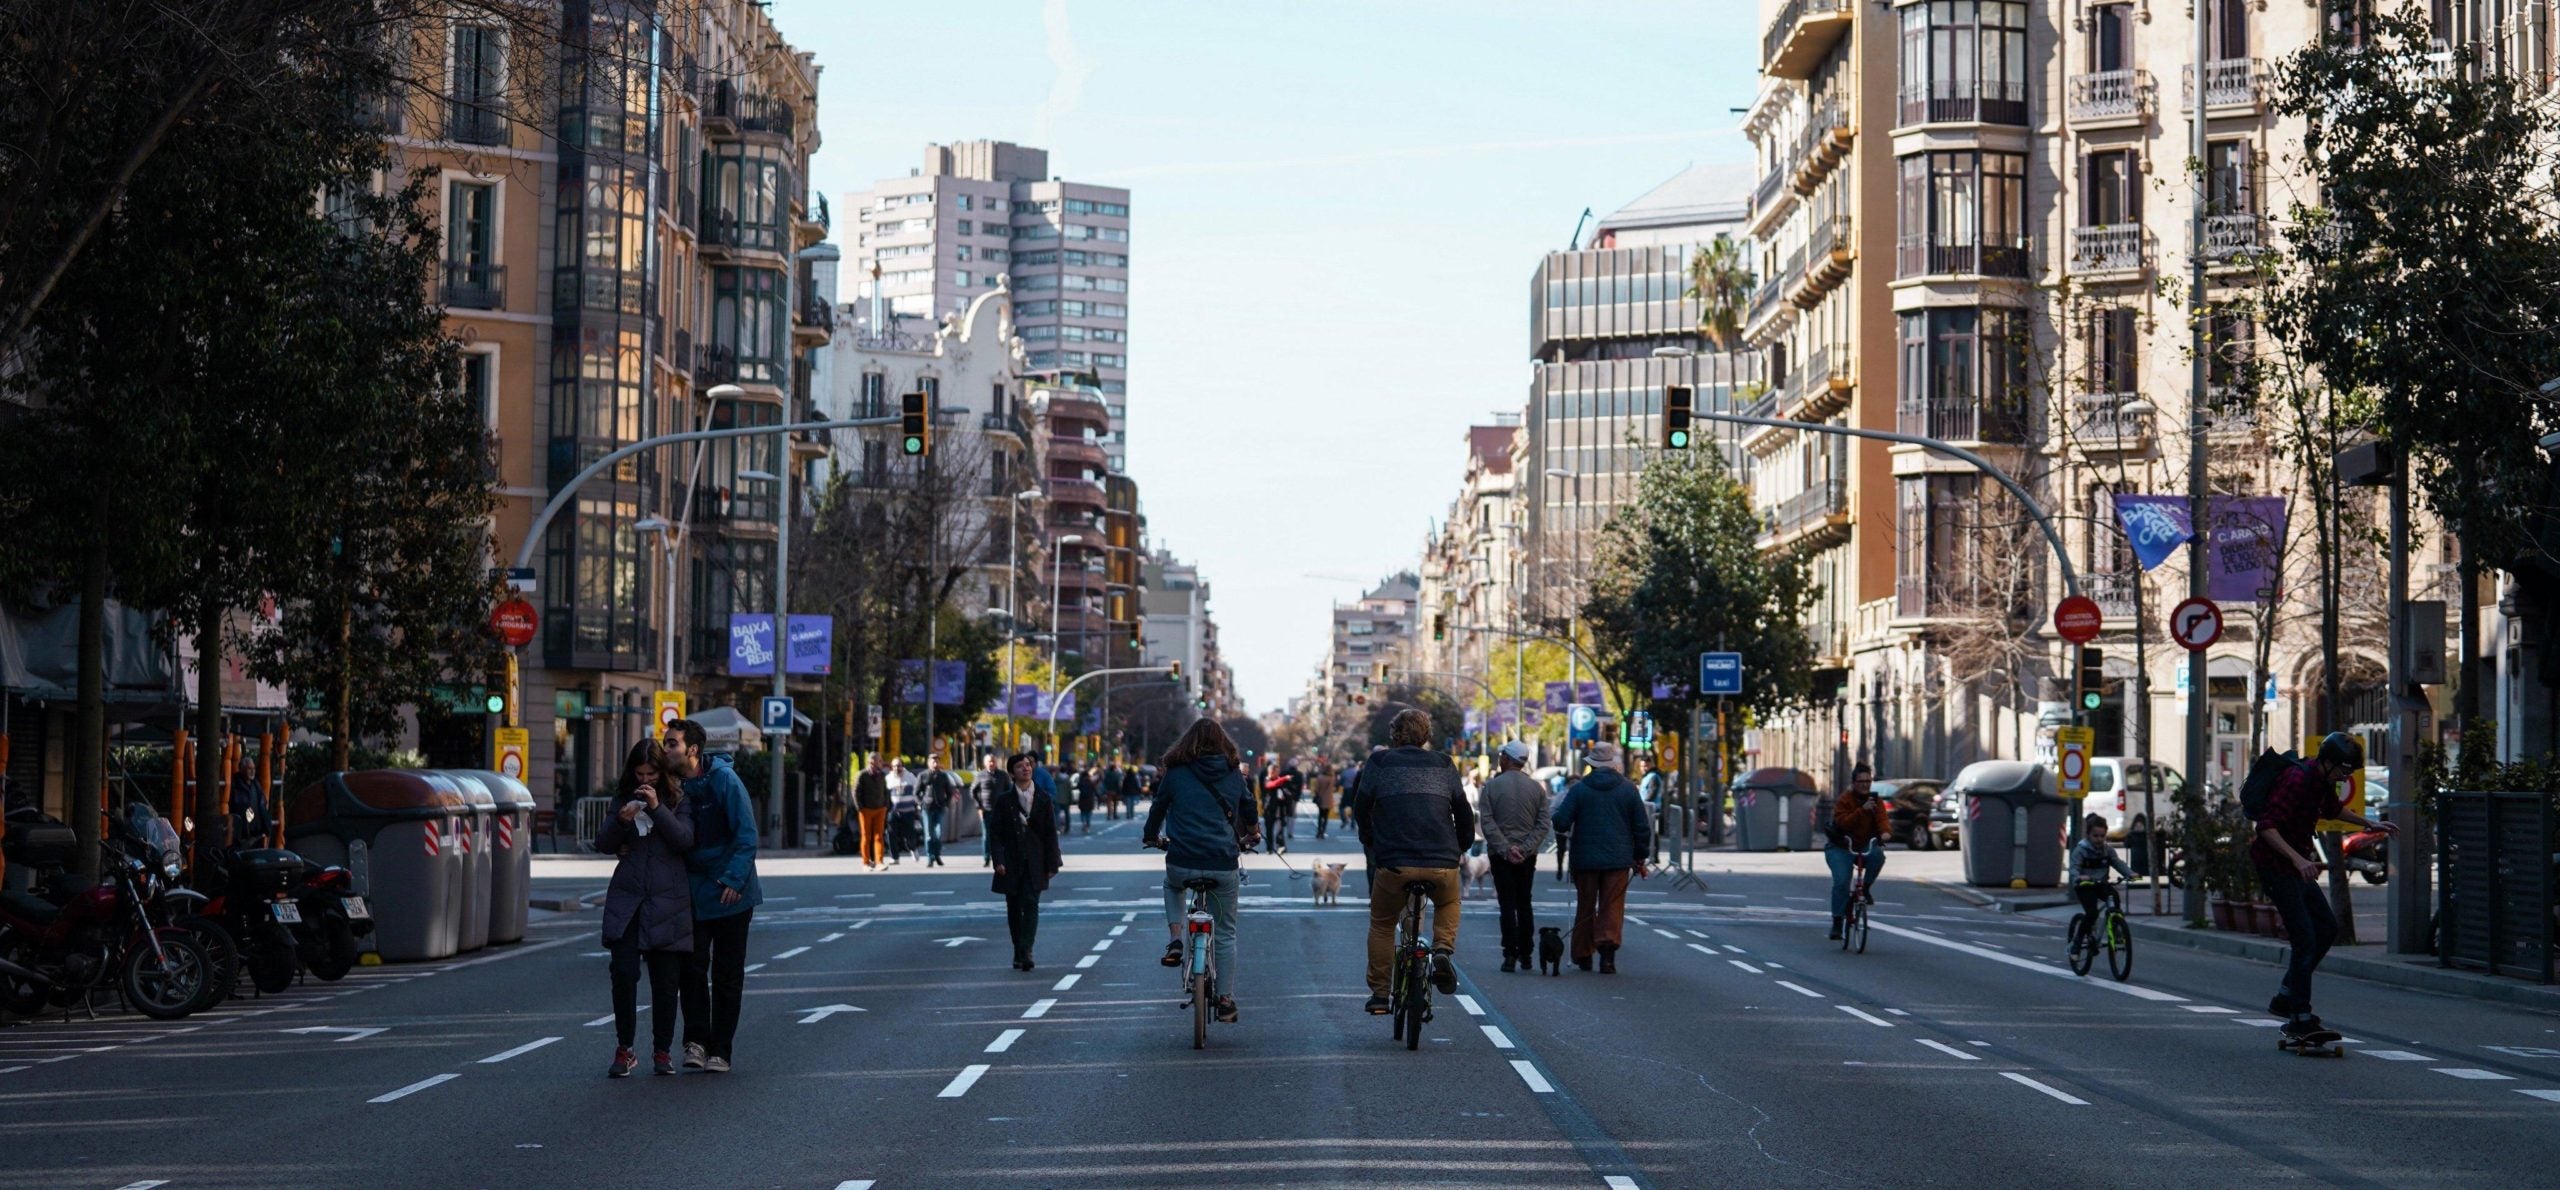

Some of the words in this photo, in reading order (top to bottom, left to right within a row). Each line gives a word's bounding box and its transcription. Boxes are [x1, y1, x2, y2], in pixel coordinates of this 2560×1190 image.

[732, 620, 770, 637] BAIXA
[743, 633, 757, 646] AL
[735, 640, 762, 658] CAR
[747, 651, 773, 666] RER!
[1713, 678, 1730, 687] taxi
[768, 700, 787, 725] P
